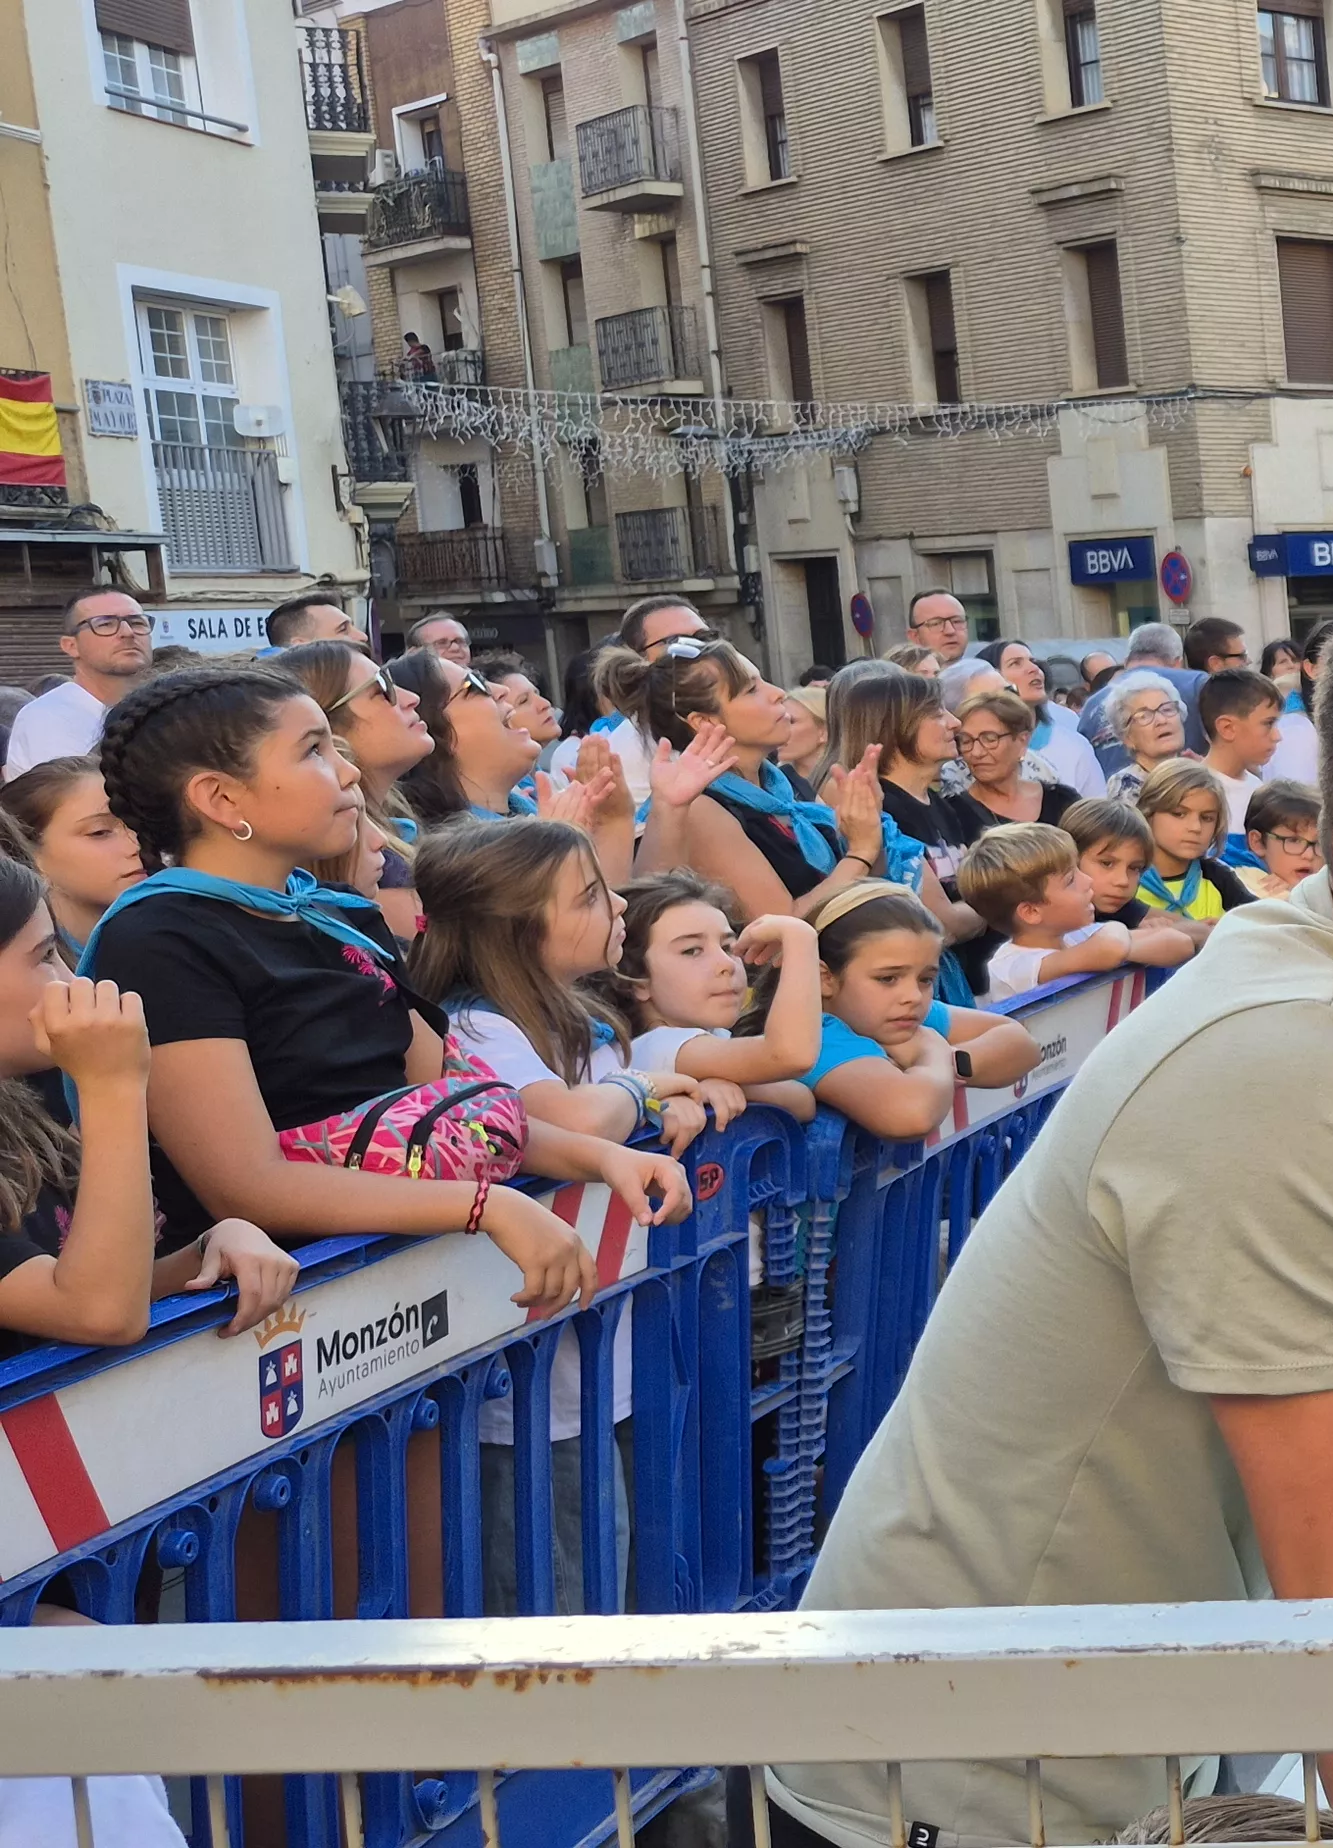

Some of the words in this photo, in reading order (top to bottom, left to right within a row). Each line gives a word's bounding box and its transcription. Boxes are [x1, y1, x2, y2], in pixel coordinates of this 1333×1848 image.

[1086, 546, 1134, 574] BBVA
[1256, 549, 1278, 561] BBVA
[188, 618, 228, 639] SALA
[234, 617, 252, 637] DE
[1039, 1033, 1067, 1061] onzón
[699, 1167, 719, 1191] SP
[317, 1302, 419, 1374] Monzón
[318, 1338, 420, 1400] Ayuntamiento
